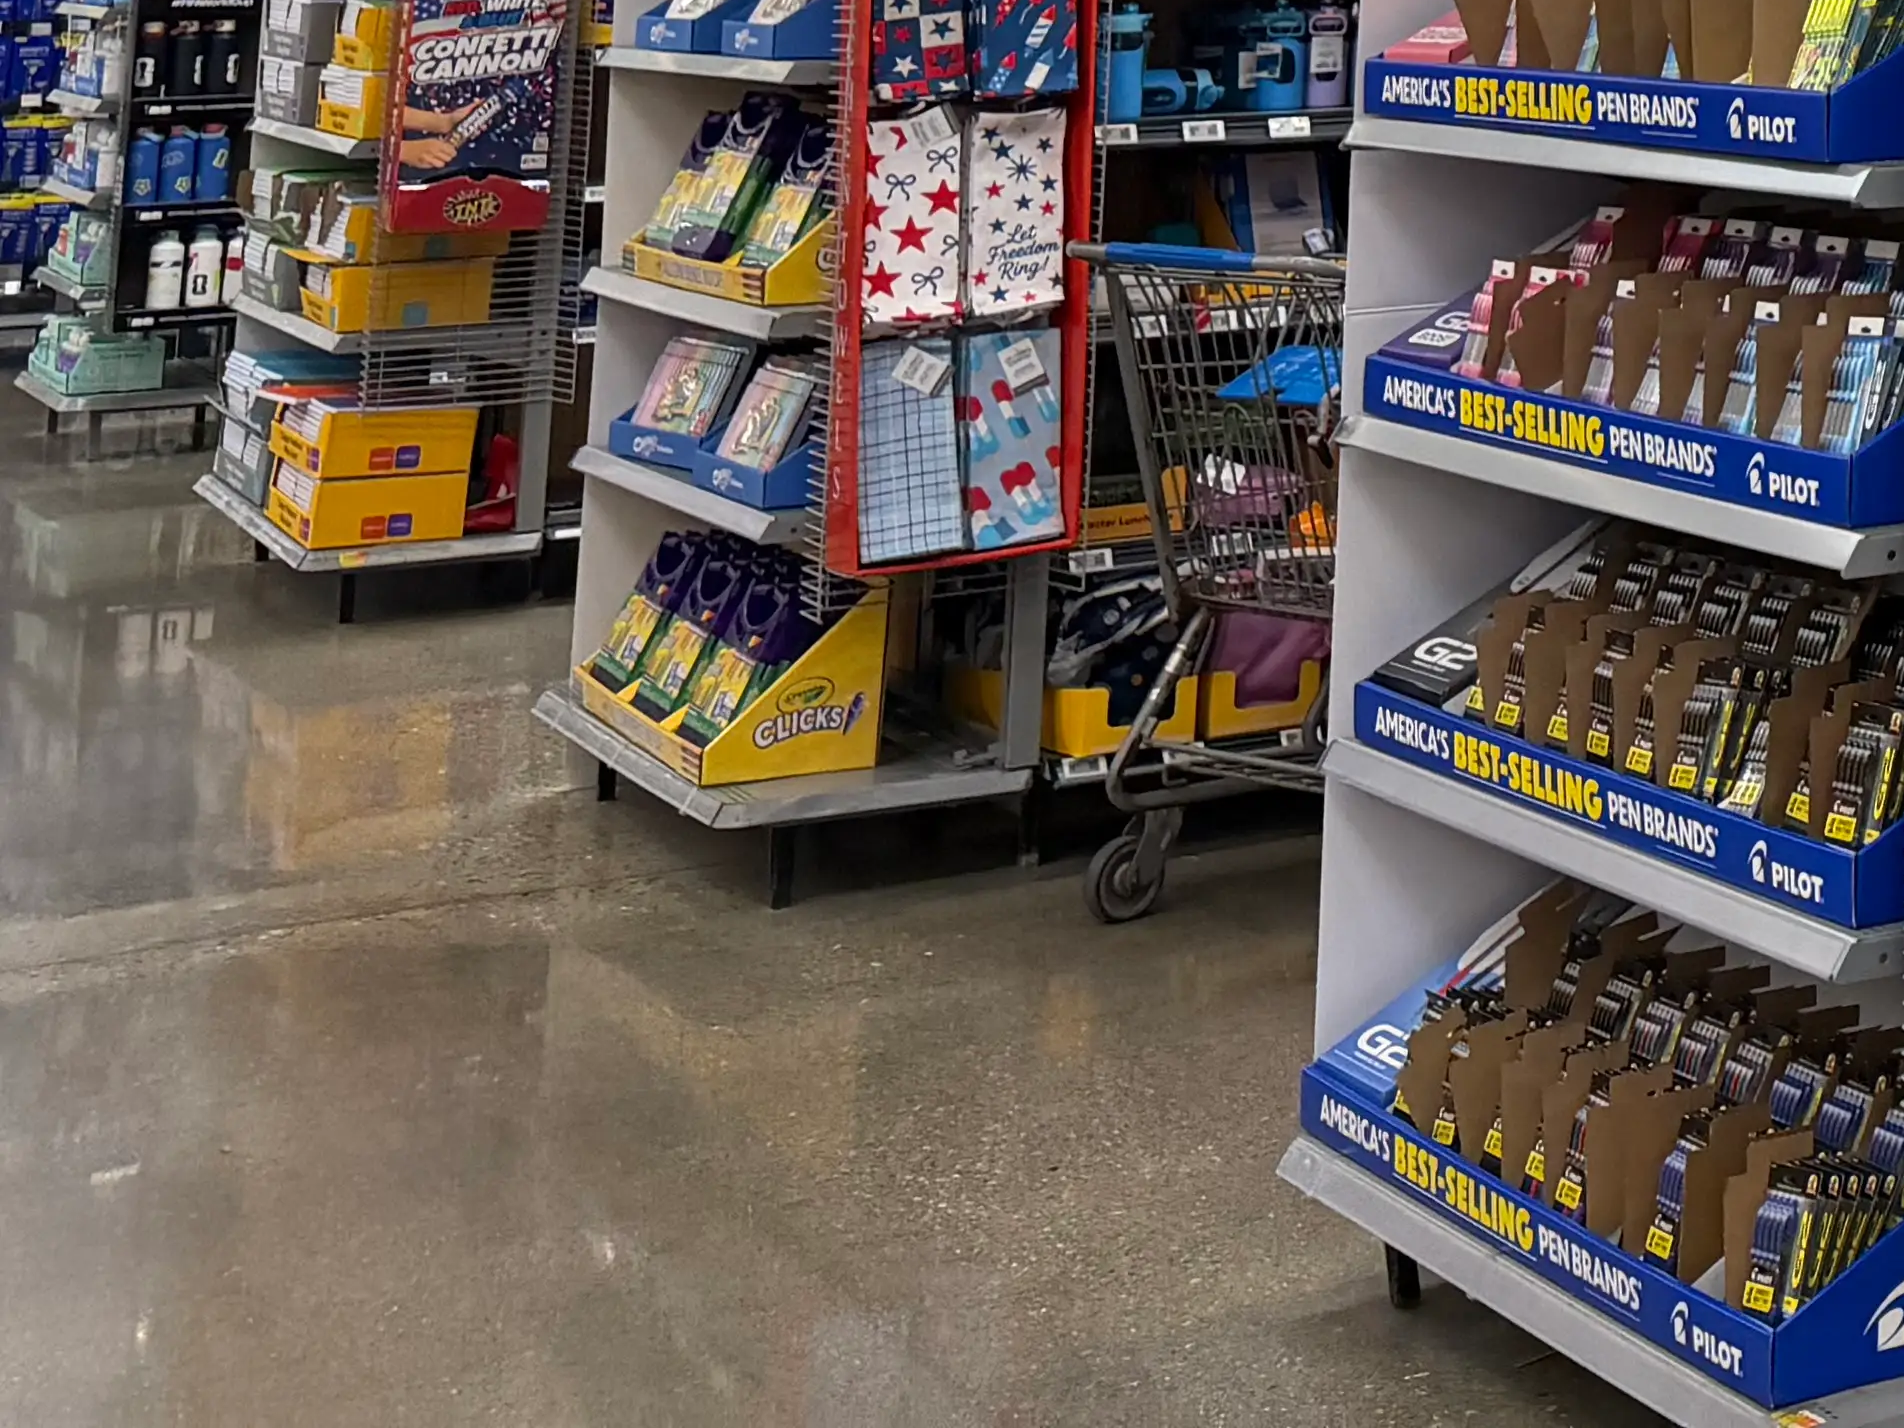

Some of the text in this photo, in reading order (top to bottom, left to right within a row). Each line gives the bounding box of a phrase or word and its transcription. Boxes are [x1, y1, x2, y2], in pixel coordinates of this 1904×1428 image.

[416, 27, 560, 61] CONFETTI
[415, 48, 546, 81] CANNON
[1381, 74, 1451, 108] AMERICA'S
[1454, 76, 1592, 125] BEST-SELLING
[1597, 92, 1629, 122] PEN
[1747, 113, 1796, 144] PILOT
[1006, 223, 1037, 242] Let
[987, 238, 1061, 266] Freedom
[997, 256, 1050, 283] Ring!
[1413, 636, 1478, 671] G2
[753, 706, 843, 750] CLICKS
[1374, 706, 1450, 761] AMERICA'S
[1452, 731, 1603, 822] BEST-SELLING
[1607, 789, 1643, 833] PEN
[1771, 862, 1823, 904] PILOT
